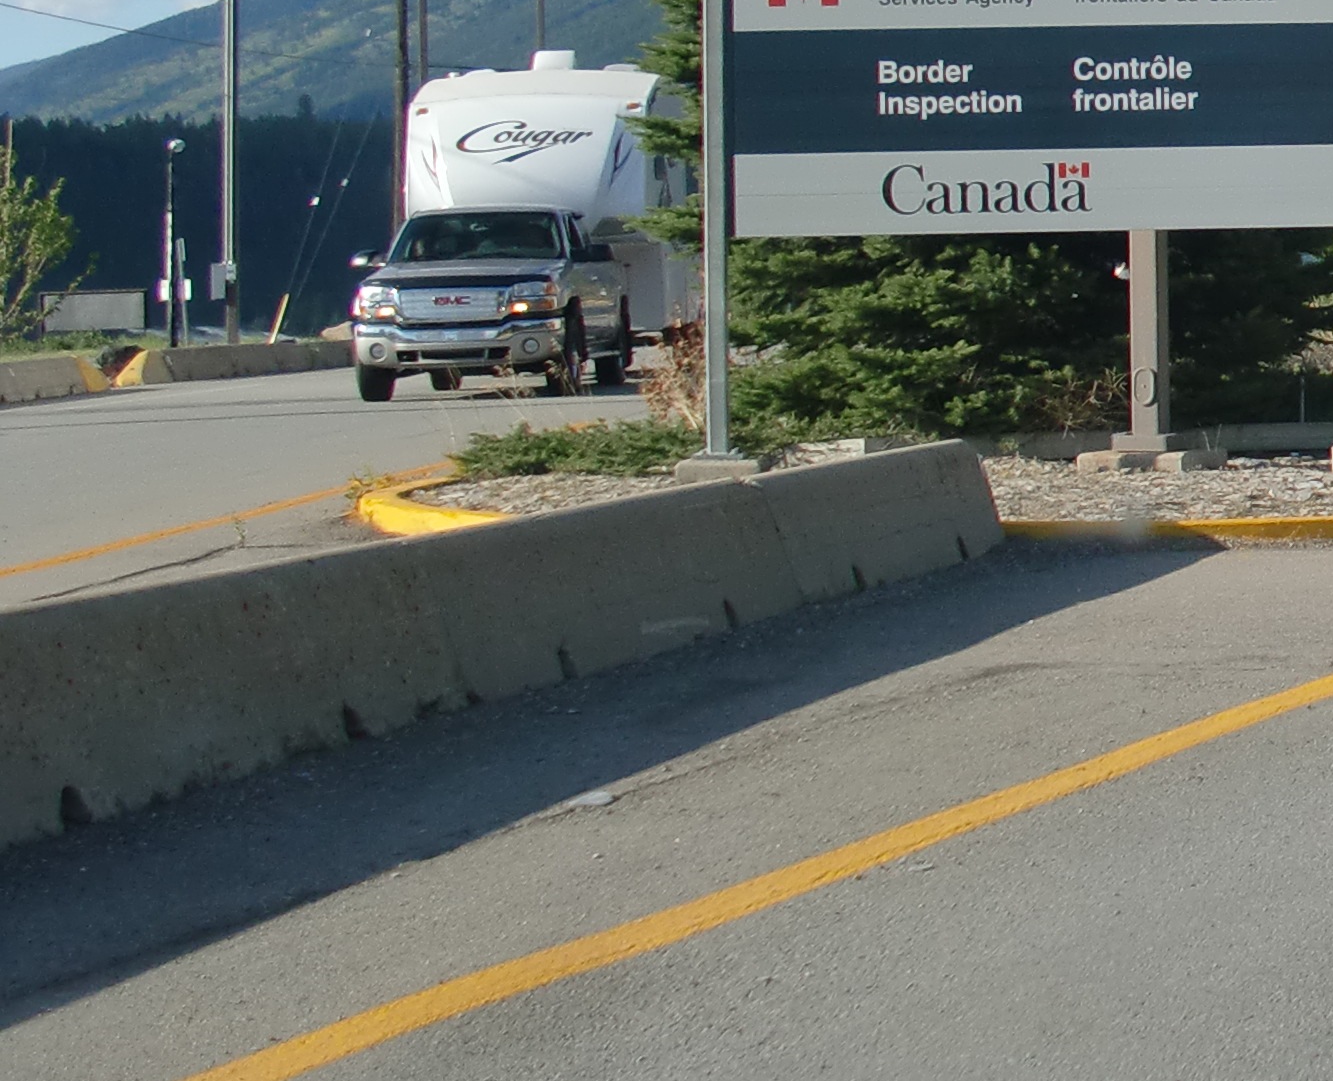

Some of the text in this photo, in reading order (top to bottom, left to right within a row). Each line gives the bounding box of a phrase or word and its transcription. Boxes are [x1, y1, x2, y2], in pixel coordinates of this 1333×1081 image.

[877, 59, 974, 84] Border
[1072, 54, 1193, 81] Contrôle
[877, 89, 1023, 120] Inspection
[1072, 86, 1199, 111] frontalier
[456, 120, 594, 157] Cougar
[881, 162, 1093, 216] Canada
